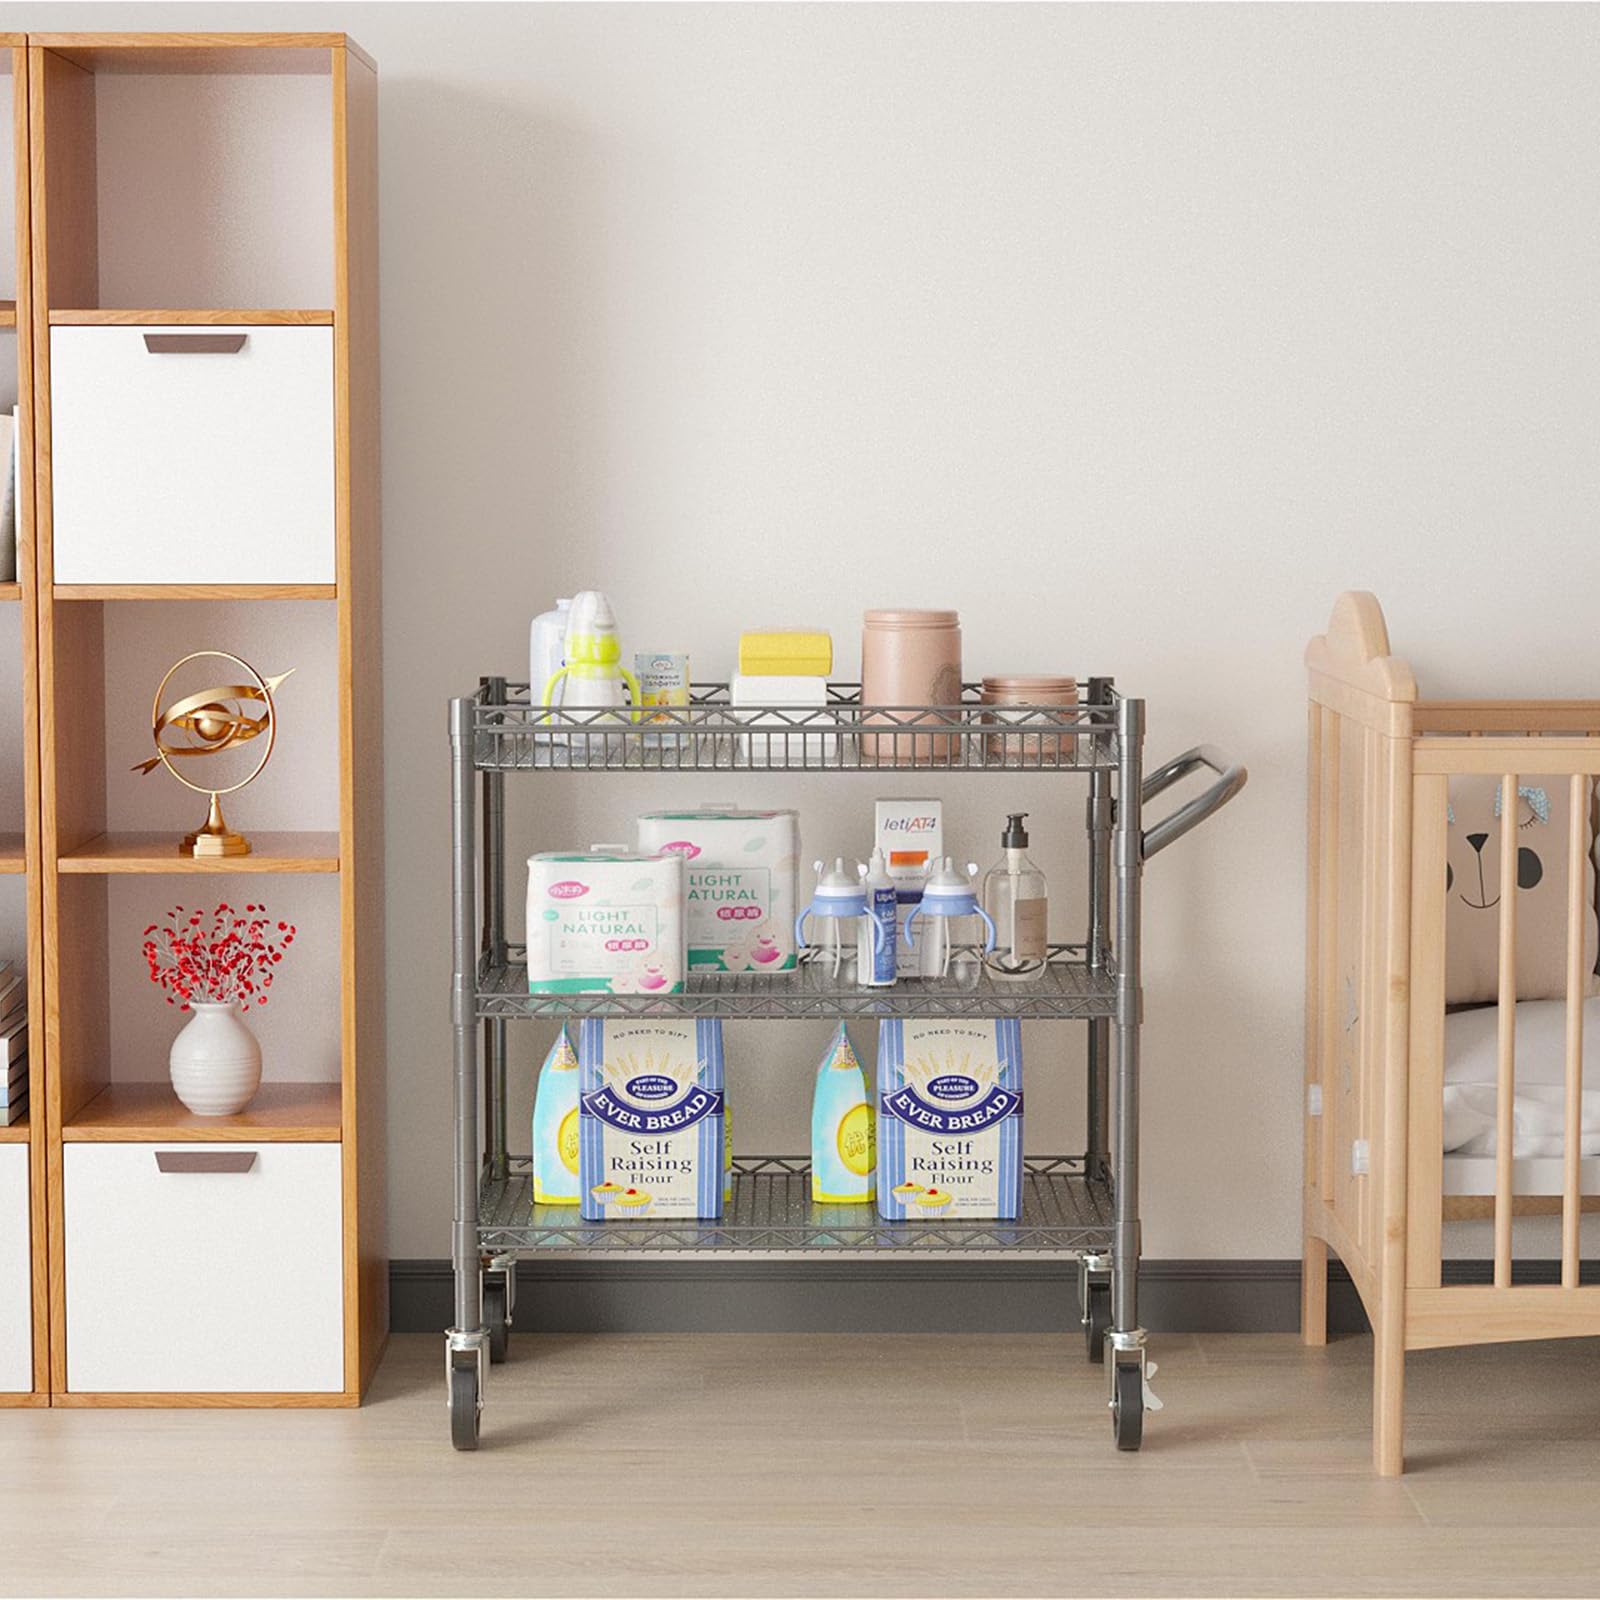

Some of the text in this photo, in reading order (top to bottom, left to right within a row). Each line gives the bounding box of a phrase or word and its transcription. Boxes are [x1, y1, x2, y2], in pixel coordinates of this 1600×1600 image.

[689, 875, 742, 886] LIGHT
[687, 889, 758, 900] ATURAL
[579, 911, 630, 921] LIGHT
[563, 924, 647, 934] NATURAL
[632, 1084, 673, 1092] PLEASURE
[933, 1084, 974, 1092] PLEASURE
[594, 1093, 707, 1130] EVER BREAD
[895, 1093, 1009, 1130] EVER BREAD
[630, 1140, 672, 1155] Self
[932, 1140, 974, 1155] Self
[611, 1156, 693, 1174] Raising
[912, 1156, 994, 1174] Raising
[630, 1173, 673, 1184] Flour
[932, 1173, 975, 1184] Flour
